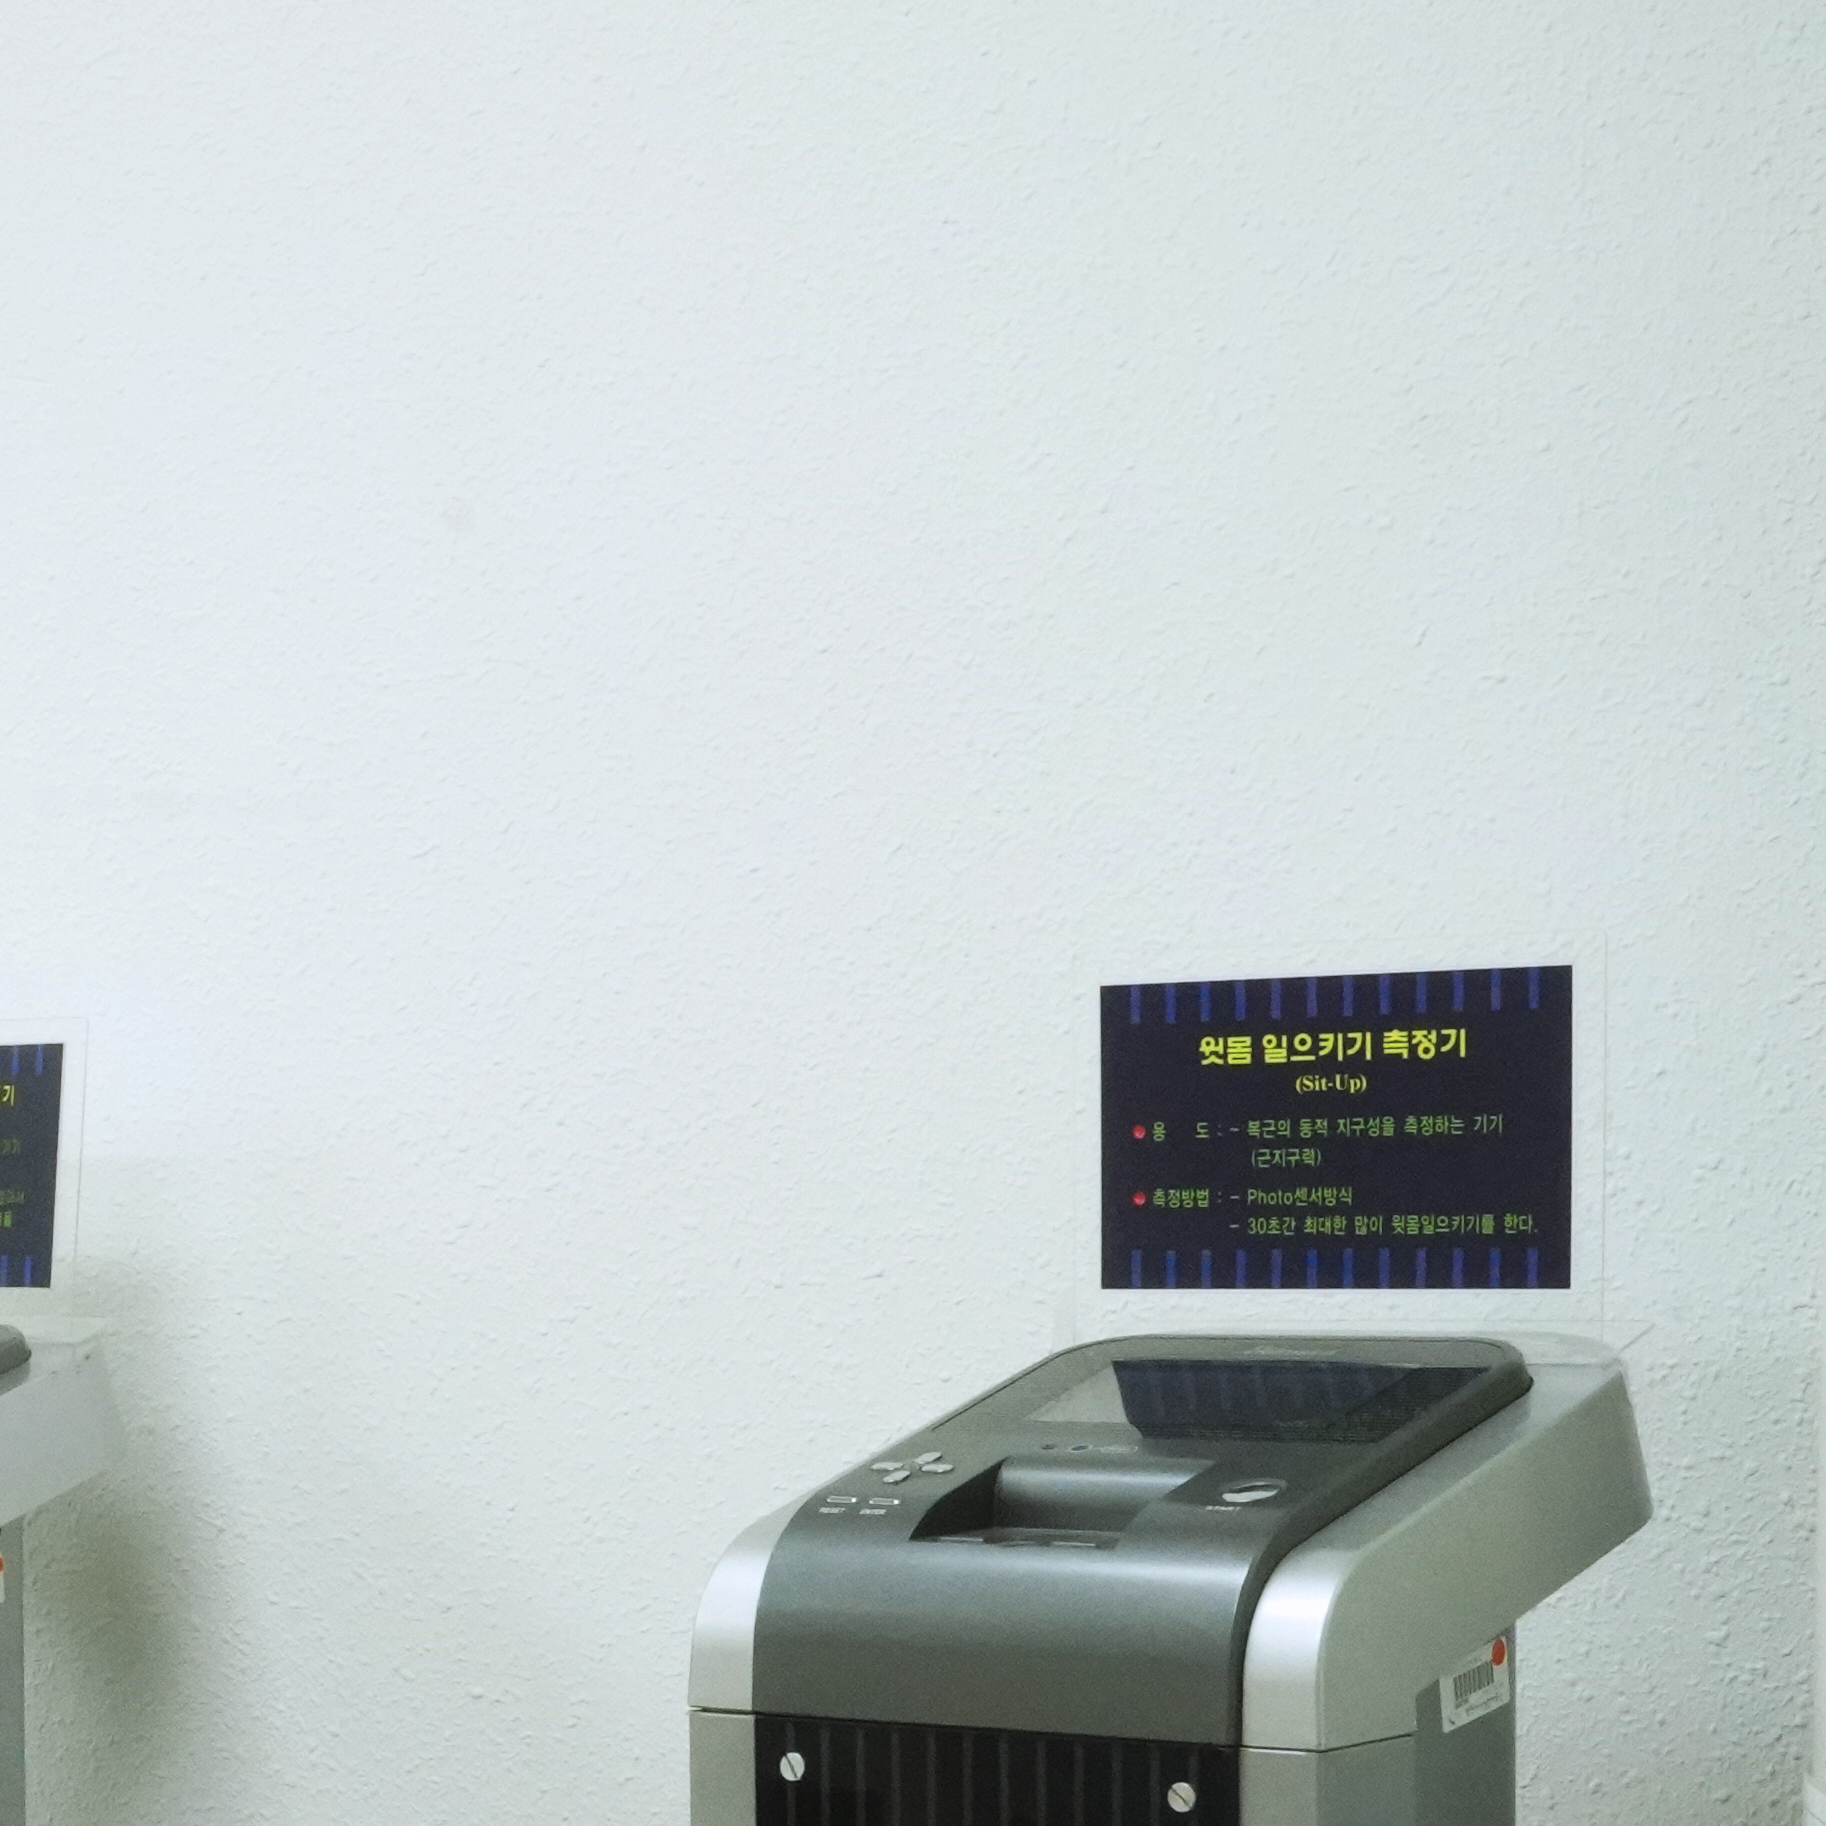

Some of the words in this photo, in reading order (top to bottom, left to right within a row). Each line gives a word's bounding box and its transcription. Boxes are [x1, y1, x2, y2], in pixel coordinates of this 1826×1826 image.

[1199, 1036, 1252, 1065] 윗몸
[1262, 1032, 1372, 1063] 일으키기
[1383, 1028, 1466, 1060] 측정기
[1295, 1073, 1367, 1094] (Sit-Up)
[1247, 1118, 1291, 1138] 복근의
[1299, 1118, 1328, 1138] 동적
[1336, 1115, 1395, 1137] 지구성을
[1404, 1115, 1465, 1136] 측정하는
[1473, 1113, 1503, 1134] 기기
[1251, 1149, 1322, 1168] (근지구력)
[1152, 1188, 1210, 1208] 측정방법
[1247, 1217, 1296, 1235] 30초간
[1303, 1215, 1346, 1235] 최대한
[1354, 1215, 1383, 1235] 많이
[1392, 1214, 1495, 1235] 윗몸일으키기를
[1504, 1213, 1538, 1234] 한다.
